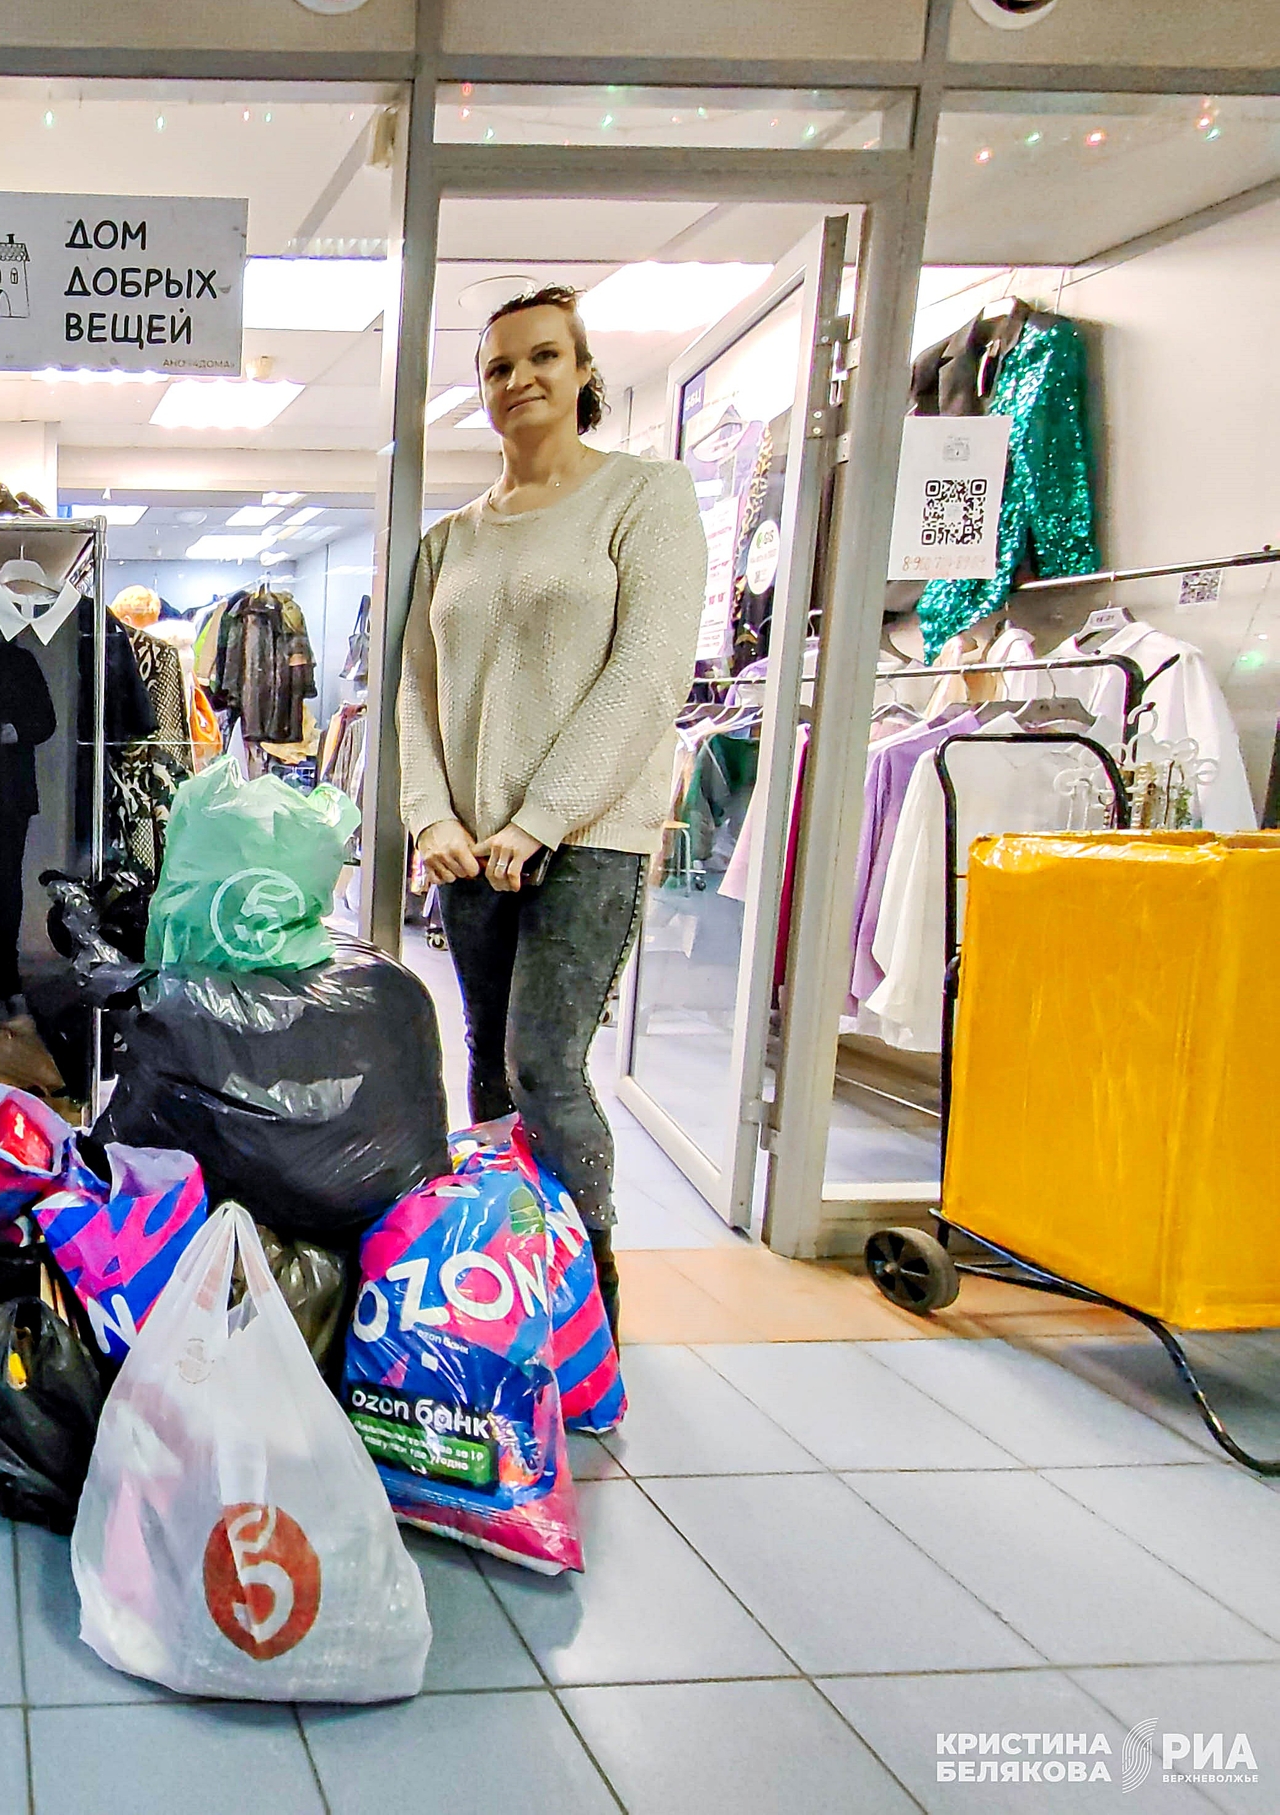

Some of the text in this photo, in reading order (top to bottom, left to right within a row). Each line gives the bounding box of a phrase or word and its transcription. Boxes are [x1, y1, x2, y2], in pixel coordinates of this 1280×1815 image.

[65, 218, 146, 250] ДОМ
[64, 266, 217, 299] ДОБРЫХ
[65, 307, 192, 350] ВЕЩЕЙ
[352, 1250, 549, 1343] OZON
[352, 1390, 409, 1419] ozon
[415, 1399, 489, 1439] банк
